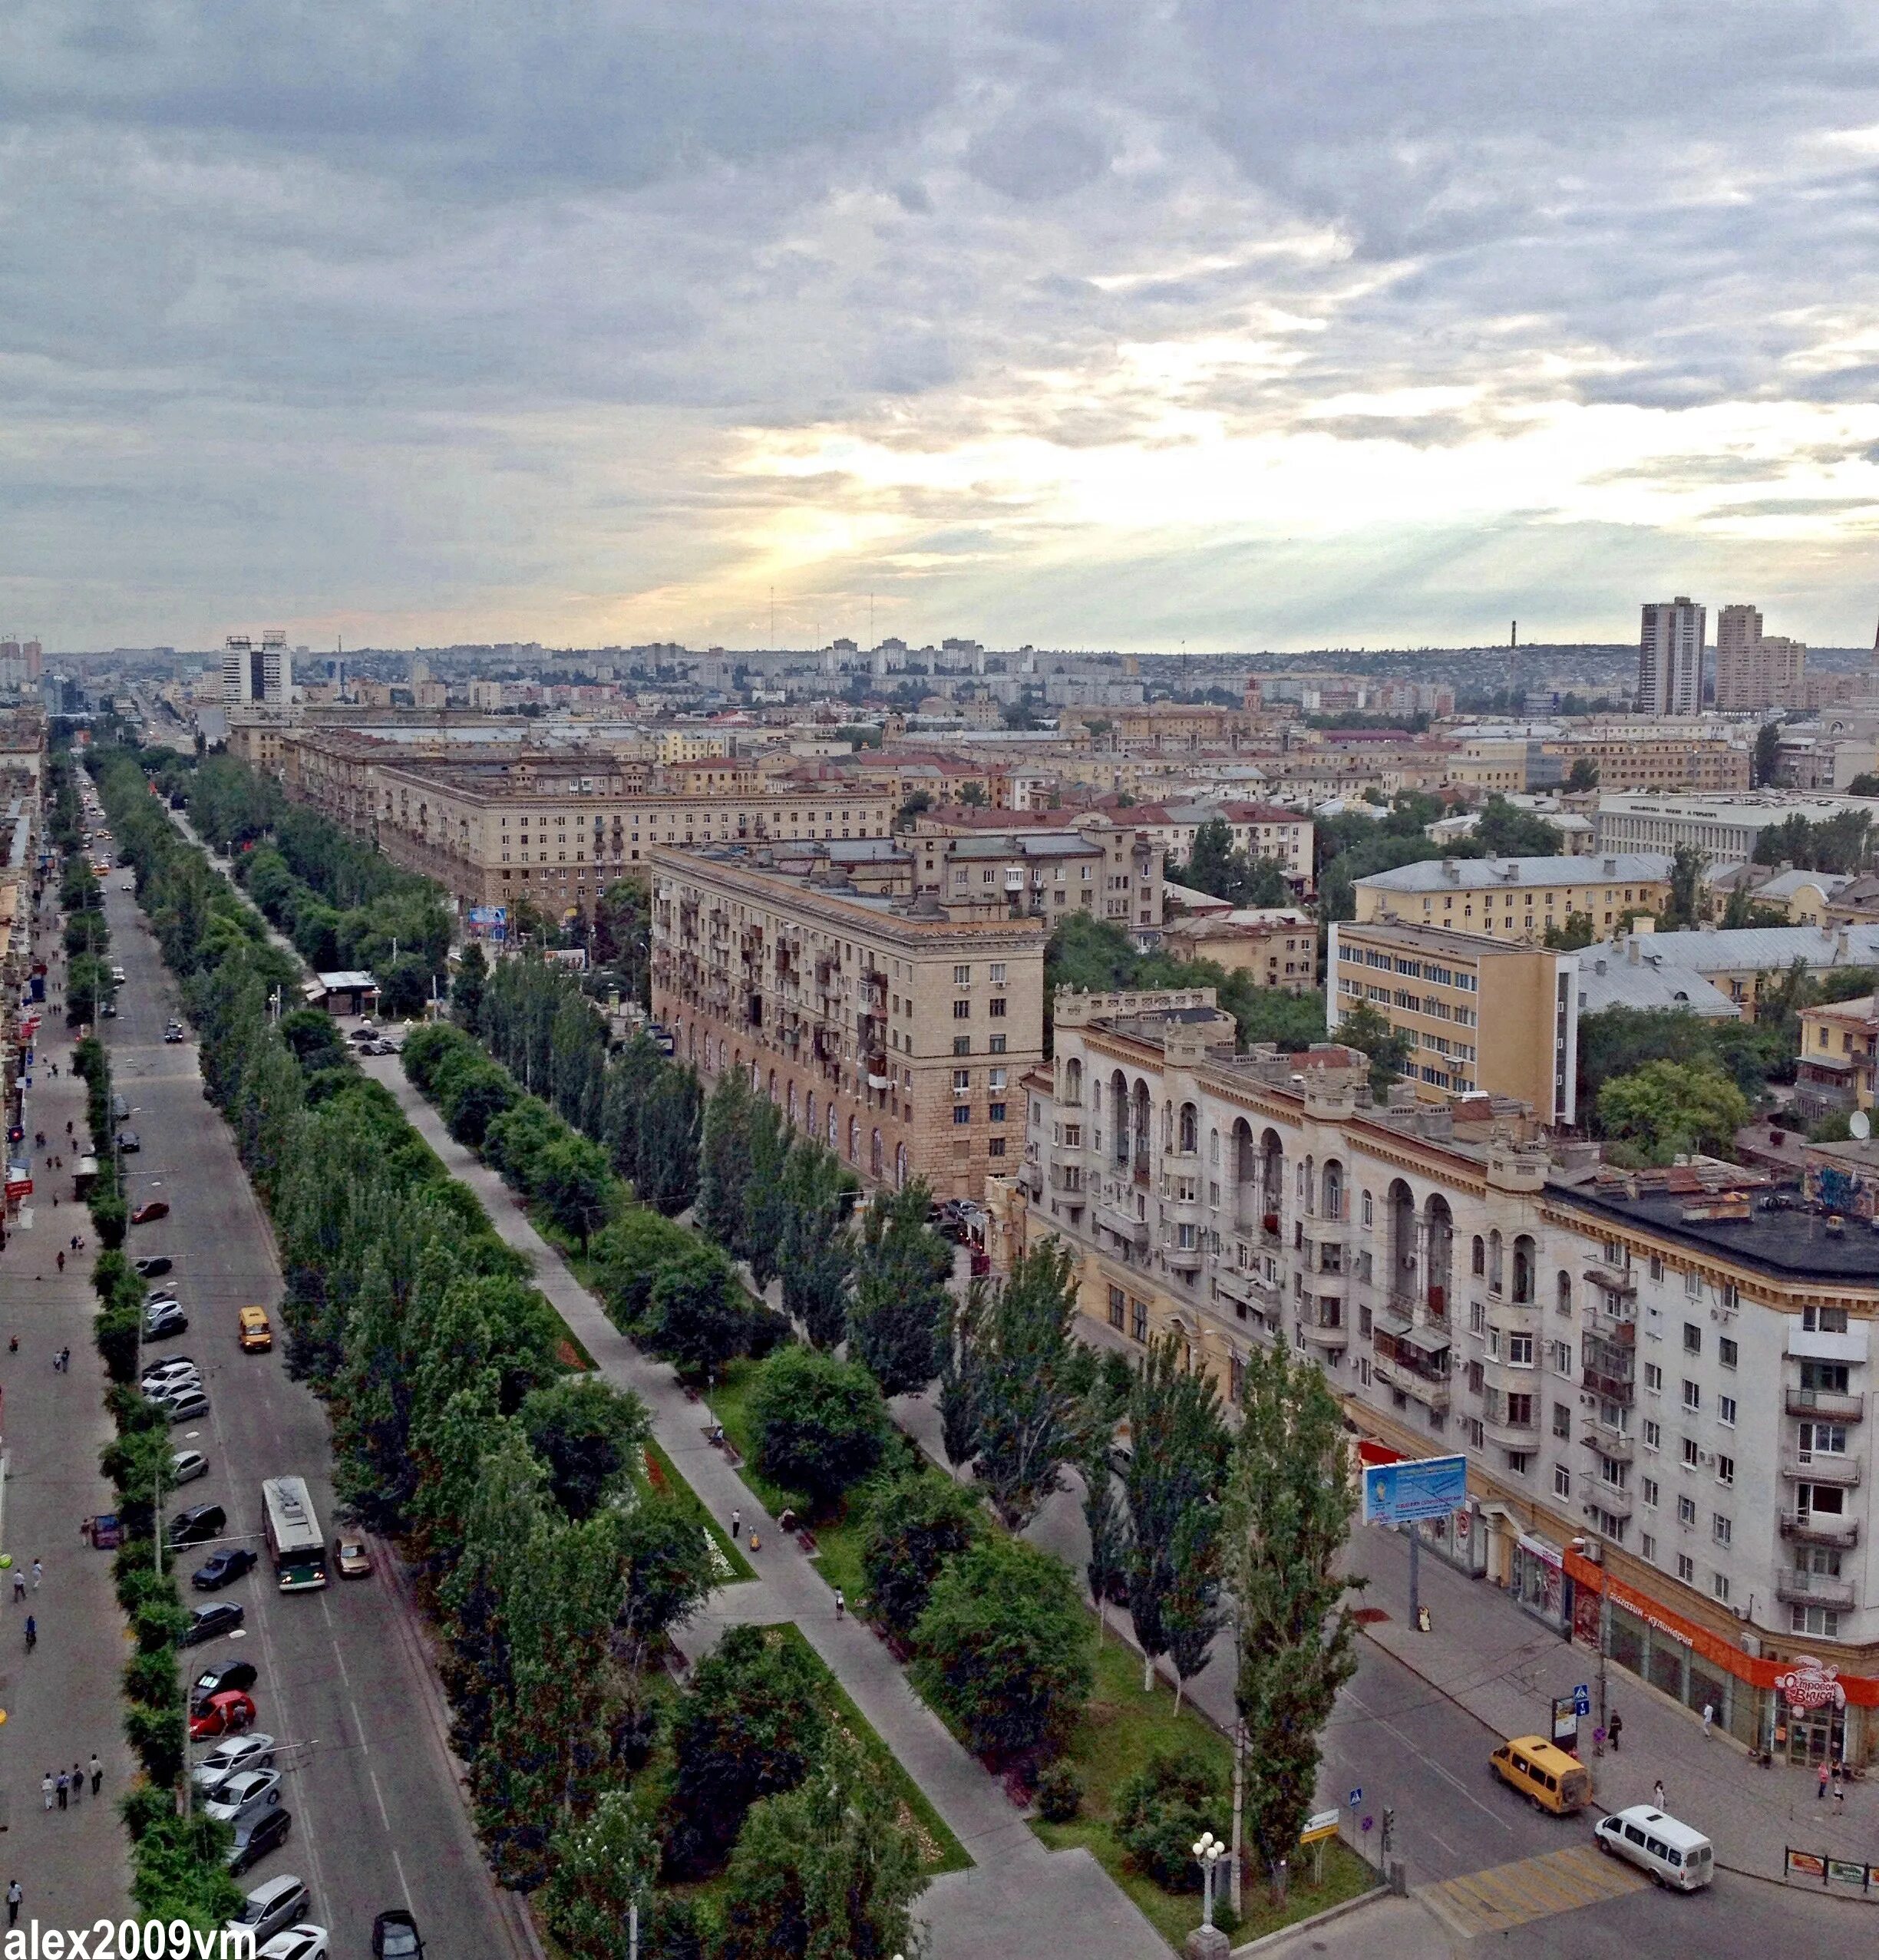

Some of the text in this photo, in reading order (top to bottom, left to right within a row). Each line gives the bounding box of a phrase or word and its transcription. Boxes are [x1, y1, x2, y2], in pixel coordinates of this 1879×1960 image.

[1648, 1615, 1693, 1647] кулинария
[1784, 1674, 1837, 1691] Островок
[1795, 1688, 1832, 1702] Вкуса
